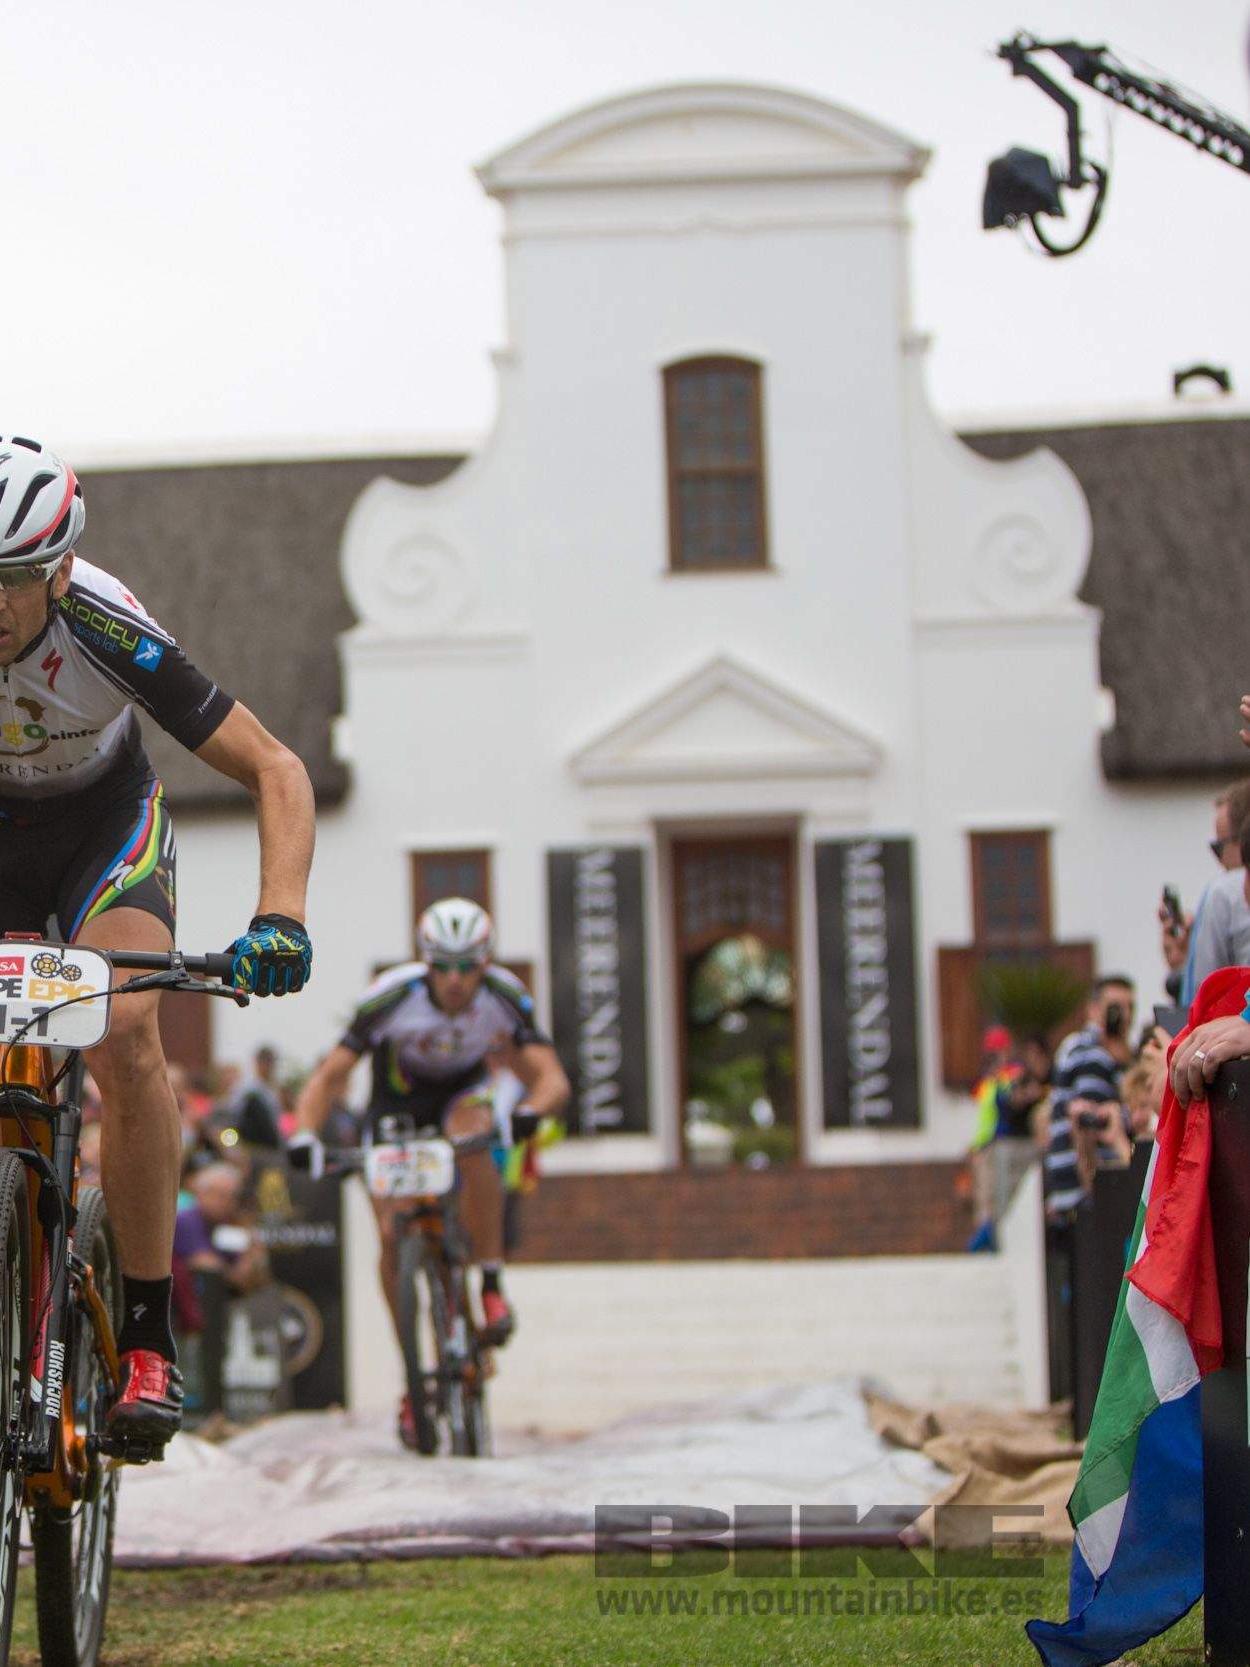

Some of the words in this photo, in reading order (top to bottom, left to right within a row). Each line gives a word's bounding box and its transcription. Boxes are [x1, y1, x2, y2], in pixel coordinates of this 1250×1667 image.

[58, 595, 139, 651] elocity
[28, 978, 96, 1006] EPIC
[45, 1339, 65, 1418] ROCKSHOX
